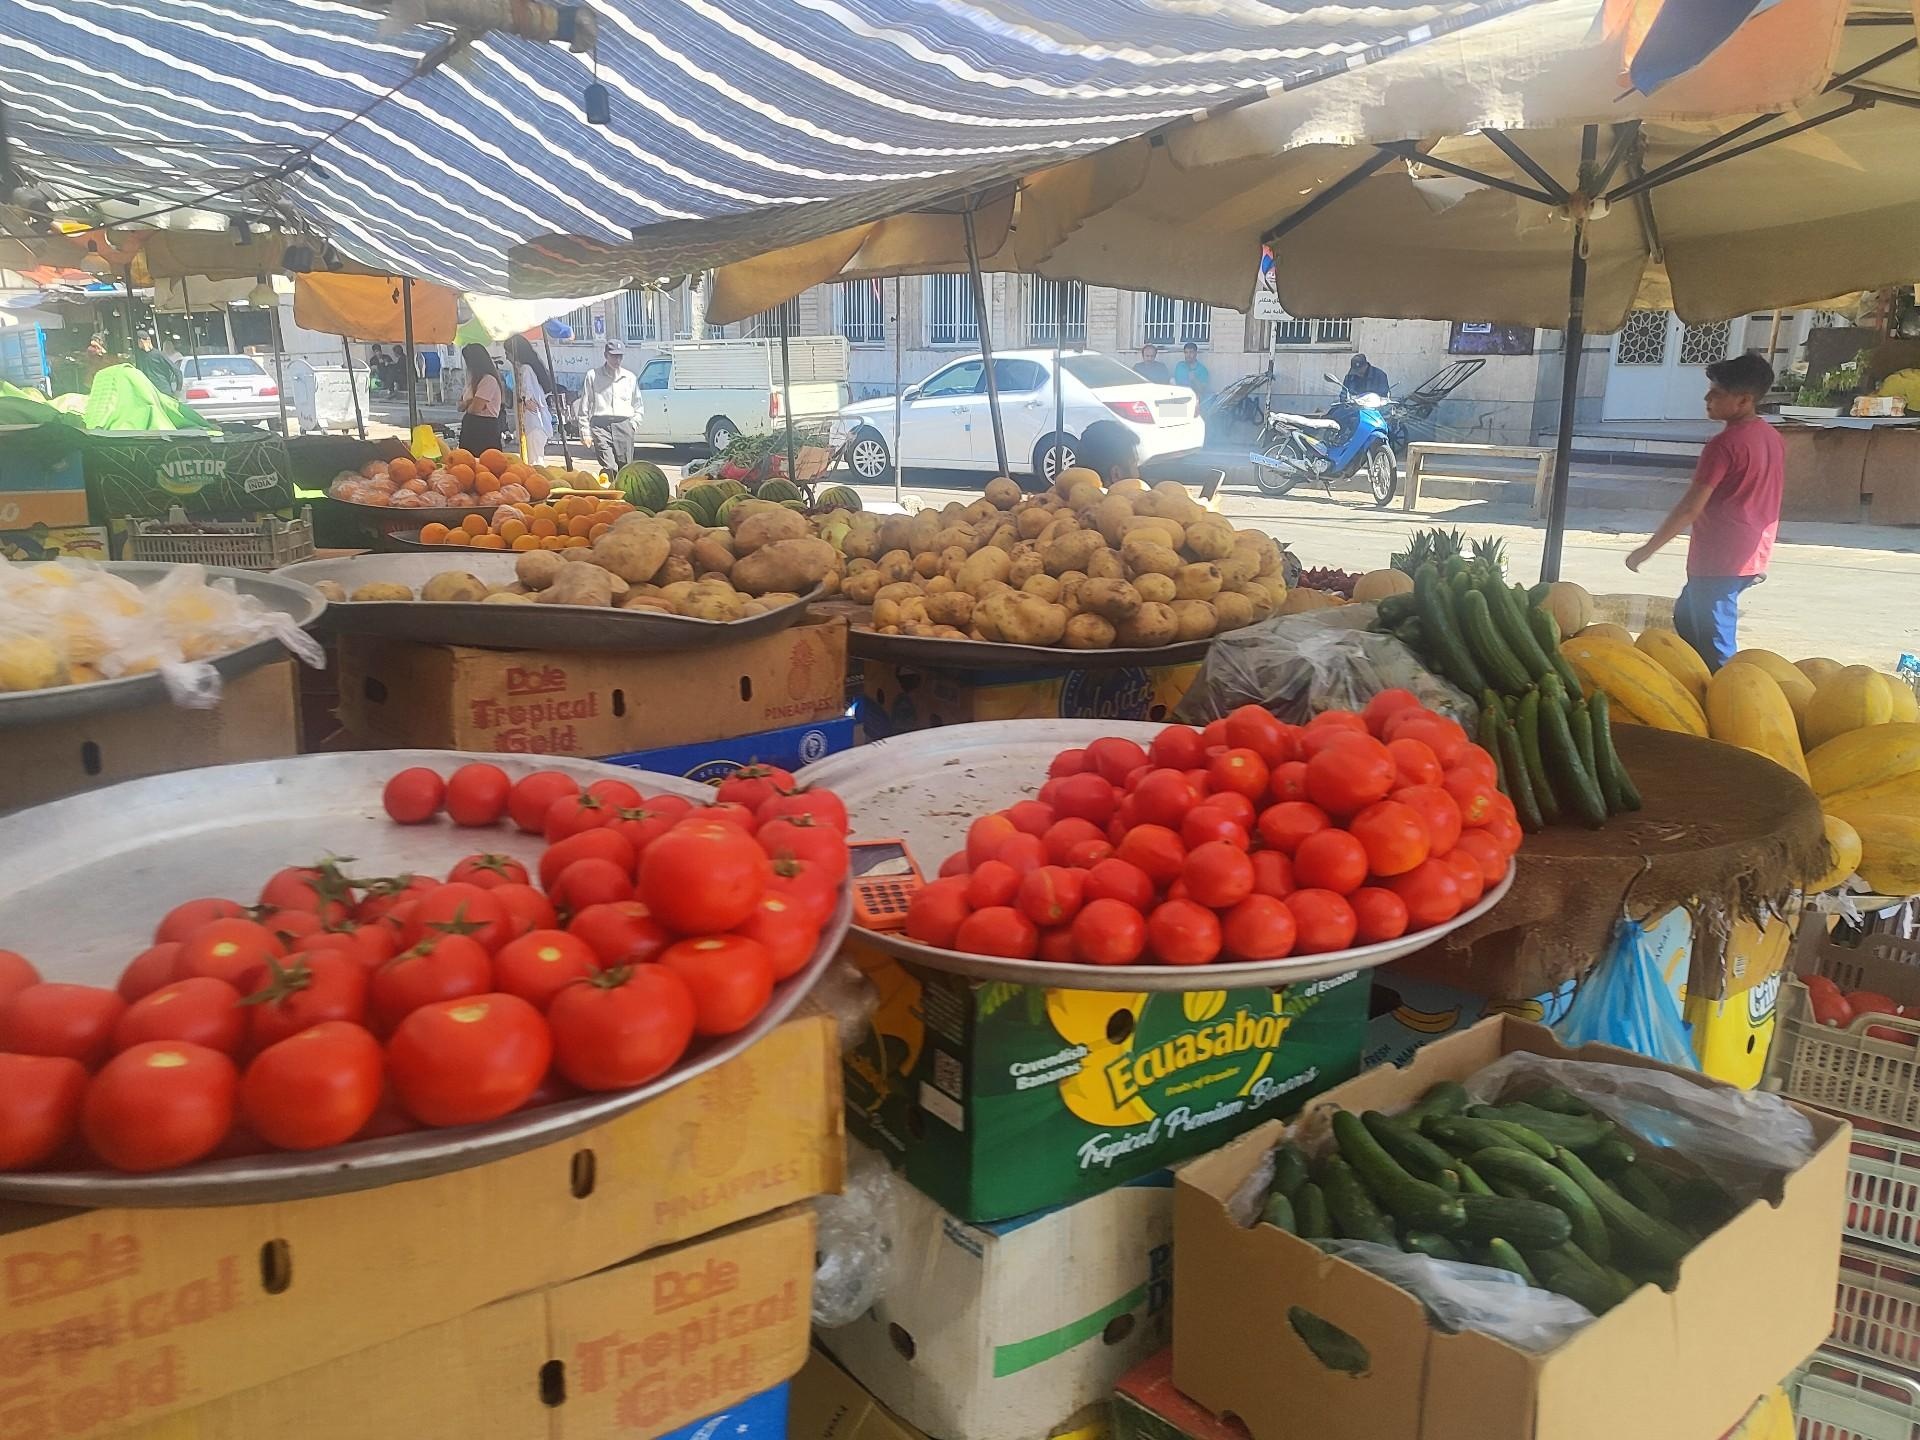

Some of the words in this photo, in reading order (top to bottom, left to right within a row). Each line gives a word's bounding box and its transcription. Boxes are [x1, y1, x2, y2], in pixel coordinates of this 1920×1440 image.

[161, 460, 226, 478] VICTOR
[248, 479, 271, 490] INDIA
[506, 666, 566, 690] Dole
[471, 692, 598, 730] Tropical
[764, 697, 833, 720] PINEAPPLES
[493, 724, 581, 754] Gold
[1318, 970, 1359, 993] Ecuador
[1009, 1042, 1088, 1076] Cavendish
[1015, 1062, 1083, 1090] Bananas
[1106, 1008, 1293, 1110] Ecuasabor
[1077, 1117, 1161, 1169] Tropical
[1164, 1106, 1244, 1138] Premium
[1248, 1066, 1320, 1110] Bananas
[654, 1161, 799, 1225] PINEAPPLES
[3, 1232, 142, 1299] Dole
[653, 1257, 740, 1308] Dole
[575, 1279, 798, 1393] Tropical
[616, 1344, 757, 1428] Gold
